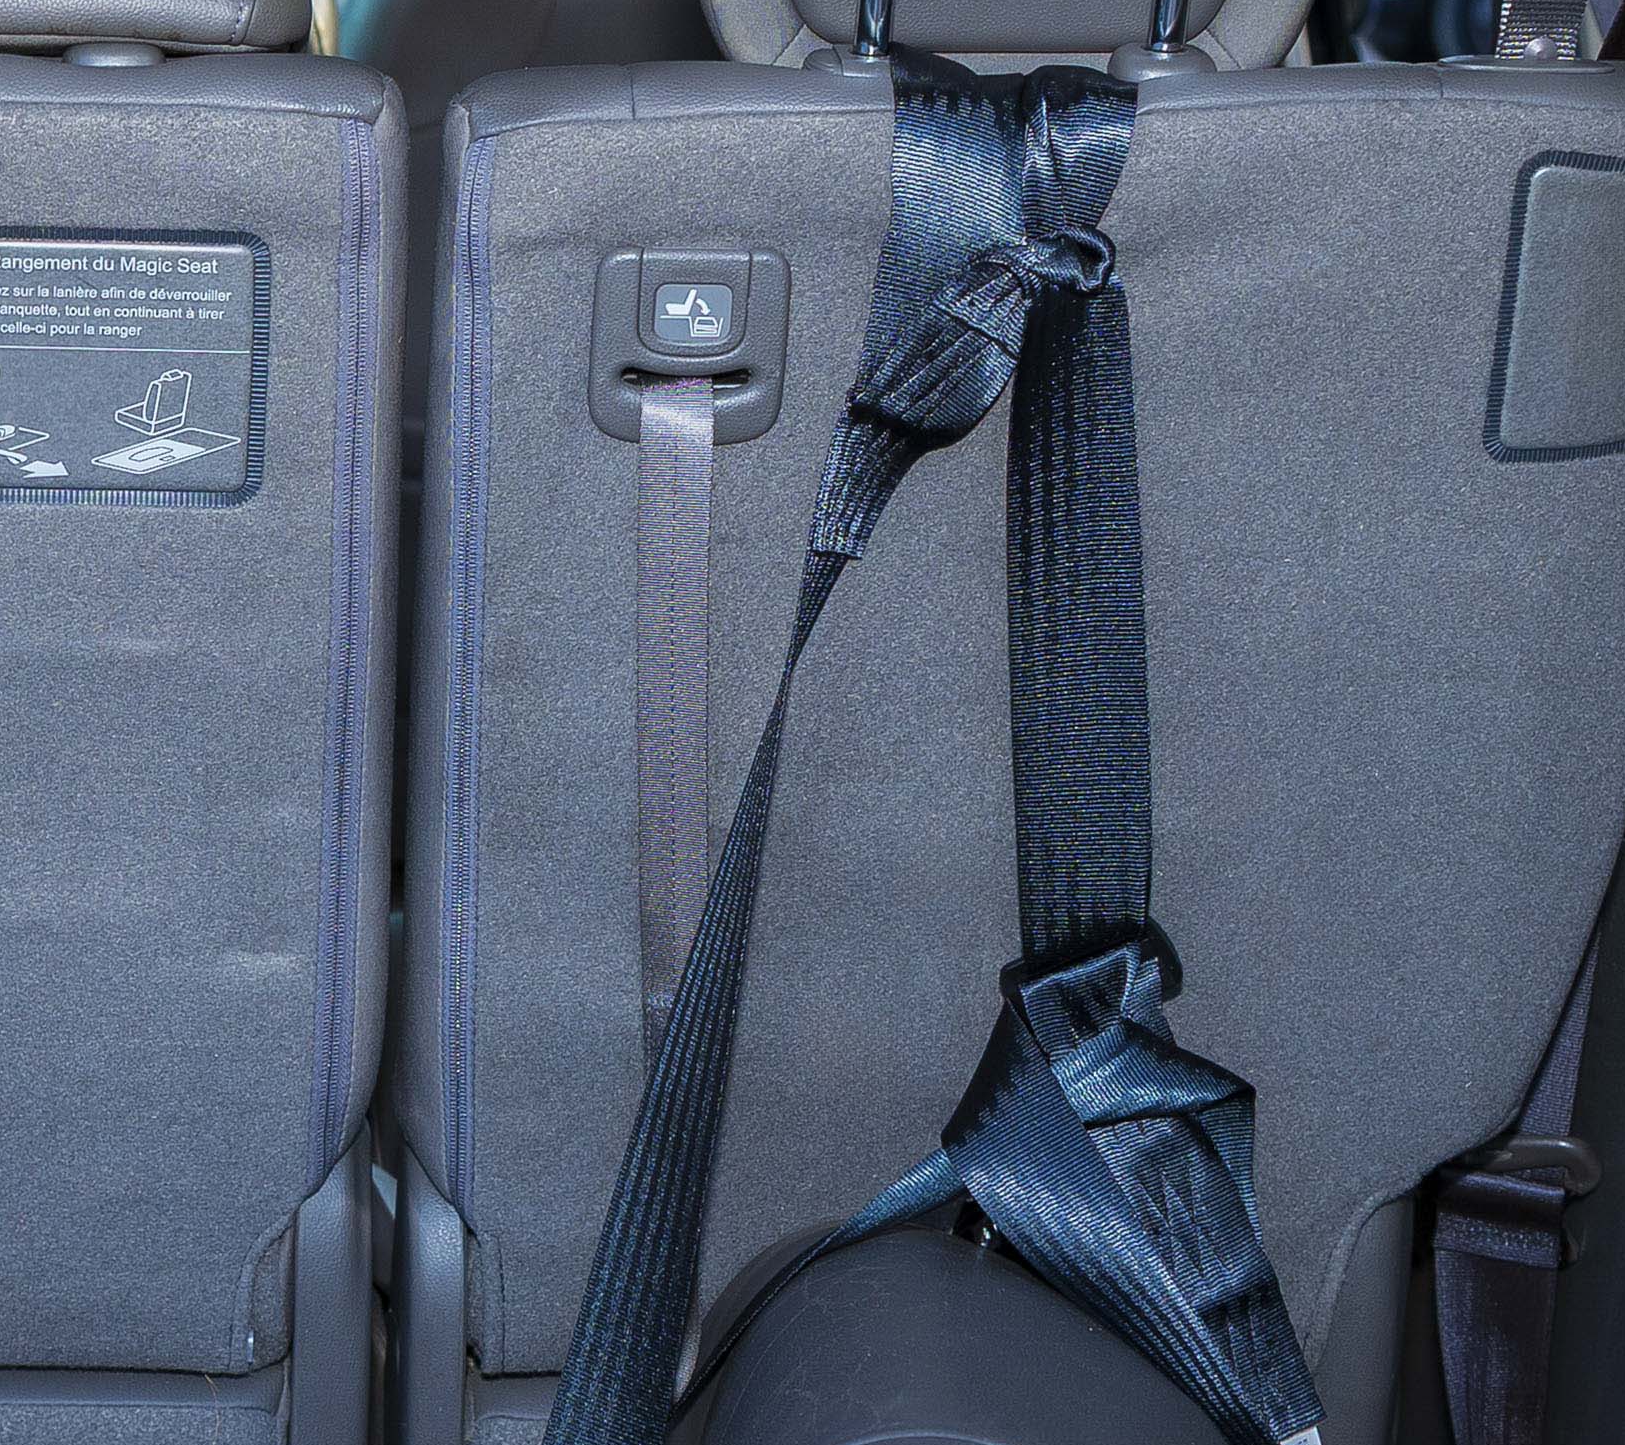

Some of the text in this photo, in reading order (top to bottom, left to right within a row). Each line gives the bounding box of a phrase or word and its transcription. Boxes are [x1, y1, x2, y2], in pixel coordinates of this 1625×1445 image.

[93, 256, 115, 271] du
[120, 257, 173, 275] Magic
[177, 258, 218, 274] Seat
[13, 288, 34, 297] sur
[37, 285, 49, 297] la
[53, 285, 97, 298] lanière
[101, 287, 125, 299] afin
[129, 288, 146, 299] de
[150, 288, 231, 302] déverrouiller
[65, 305, 90, 317] tout
[95, 307, 110, 317] en
[114, 306, 182, 319] continuant
[186, 307, 194, 319] à
[198, 308, 225, 320] tirer
[0, 322, 46, 334] celle-ci
[50, 324, 79, 337] pour
[83, 323, 94, 335] la
[99, 326, 142, 337] ranger
